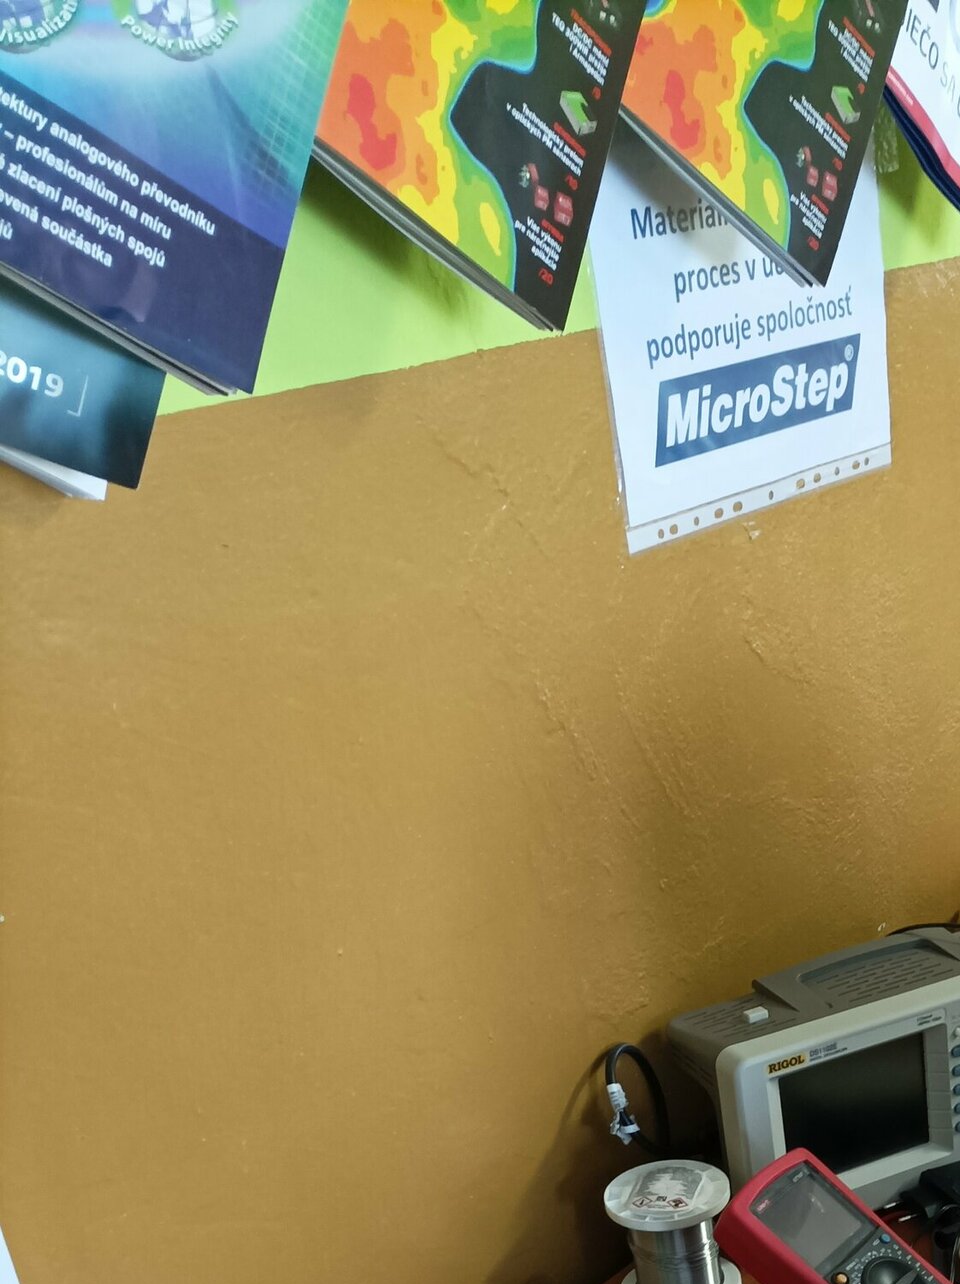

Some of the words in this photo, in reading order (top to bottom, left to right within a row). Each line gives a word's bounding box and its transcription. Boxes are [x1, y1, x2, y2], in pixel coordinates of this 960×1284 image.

[121, 14, 175, 50] Power
[179, 12, 239, 50] Integrity
[940, 61, 956, 102] SA
[16, 135, 118, 206] profesionálům
[120, 199, 139, 219] na
[140, 212, 172, 240] míru
[50, 122, 139, 187] analogového
[141, 180, 216, 236] převodníku
[7, 163, 61, 202] zlacení
[62, 195, 125, 243] plošných
[127, 236, 166, 268] spojů
[41, 216, 113, 267] součástka
[674, 260, 741, 303] proces
[745, 259, 756, 280] v
[647, 313, 751, 369] podporuje
[757, 285, 852, 342] spoločnosť
[666, 362, 849, 448] MicroStep
[768, 1055, 805, 1074] RIGOL
